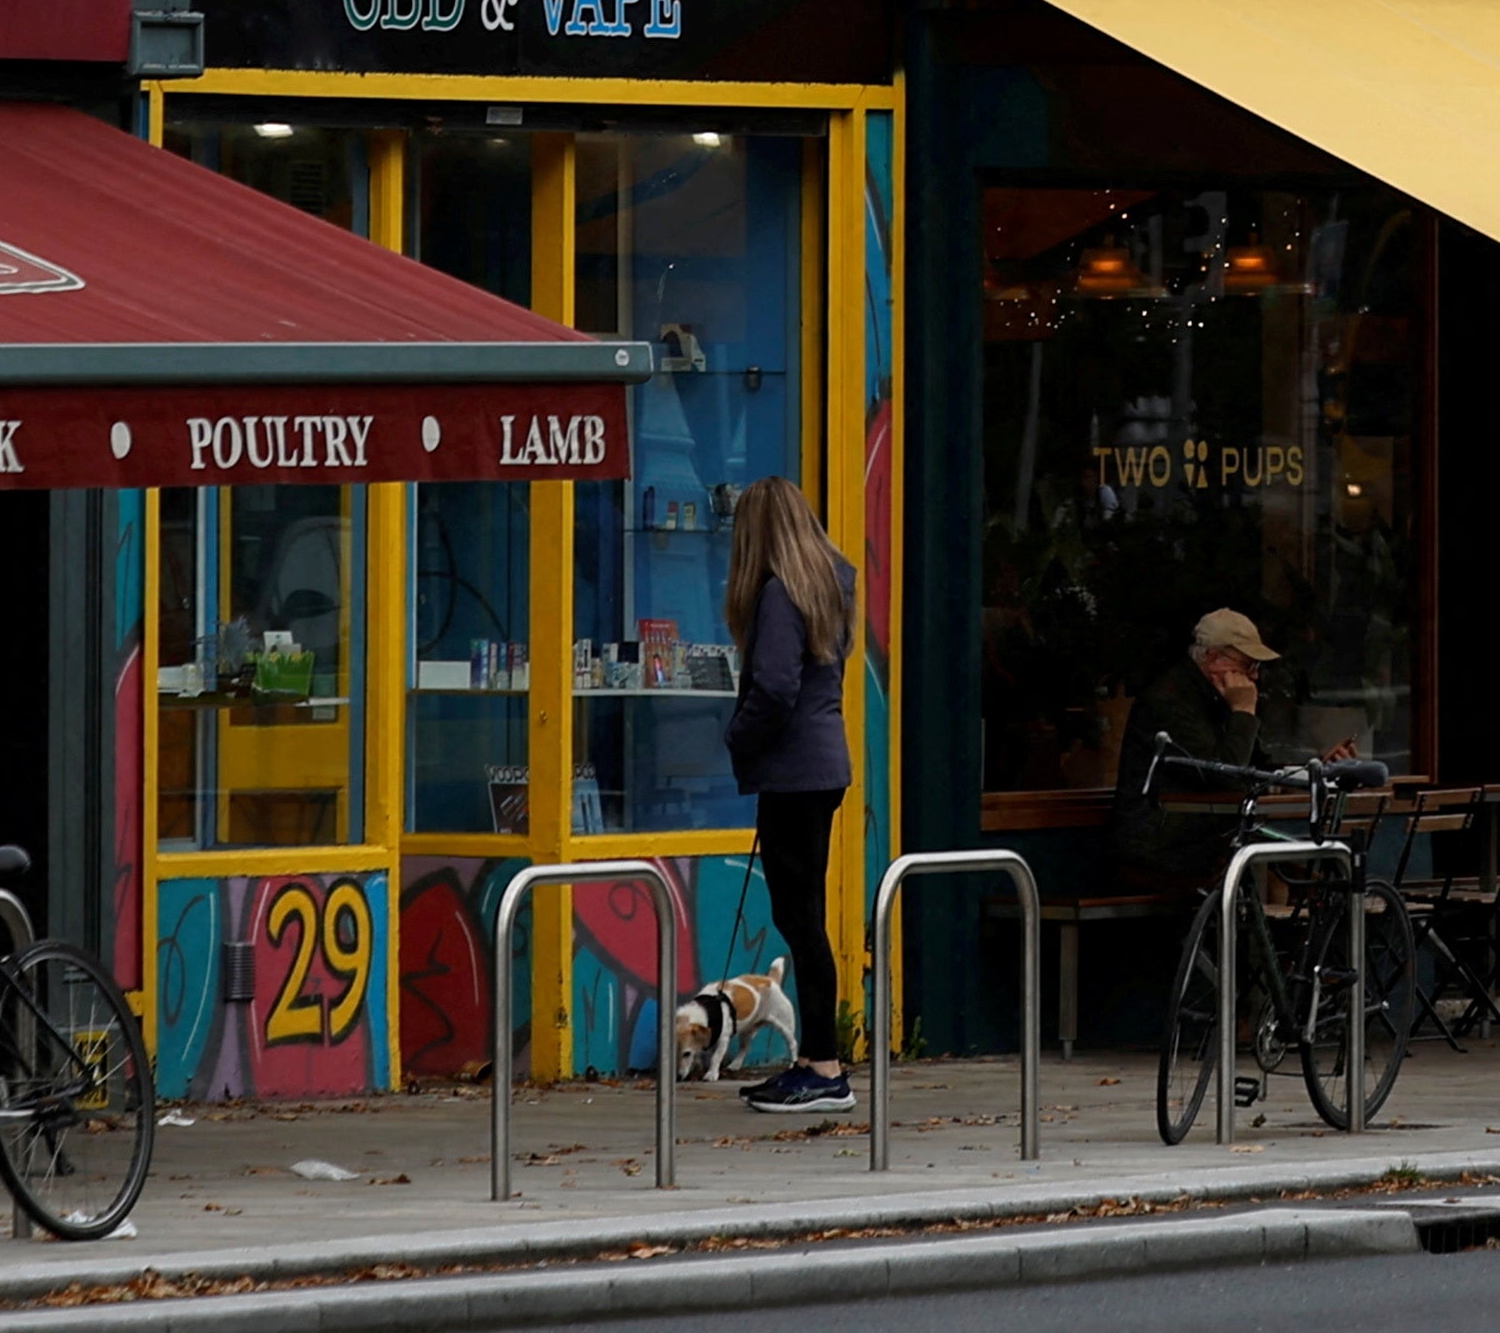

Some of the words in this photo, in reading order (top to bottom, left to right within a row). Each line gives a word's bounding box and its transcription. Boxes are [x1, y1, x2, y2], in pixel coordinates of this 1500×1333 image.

[186, 415, 374, 471] POULTRY
[499, 414, 607, 466] LAMB
[1092, 445, 1171, 487] TWO
[1221, 445, 1304, 487] PUPS
[265, 880, 372, 1045] 29
